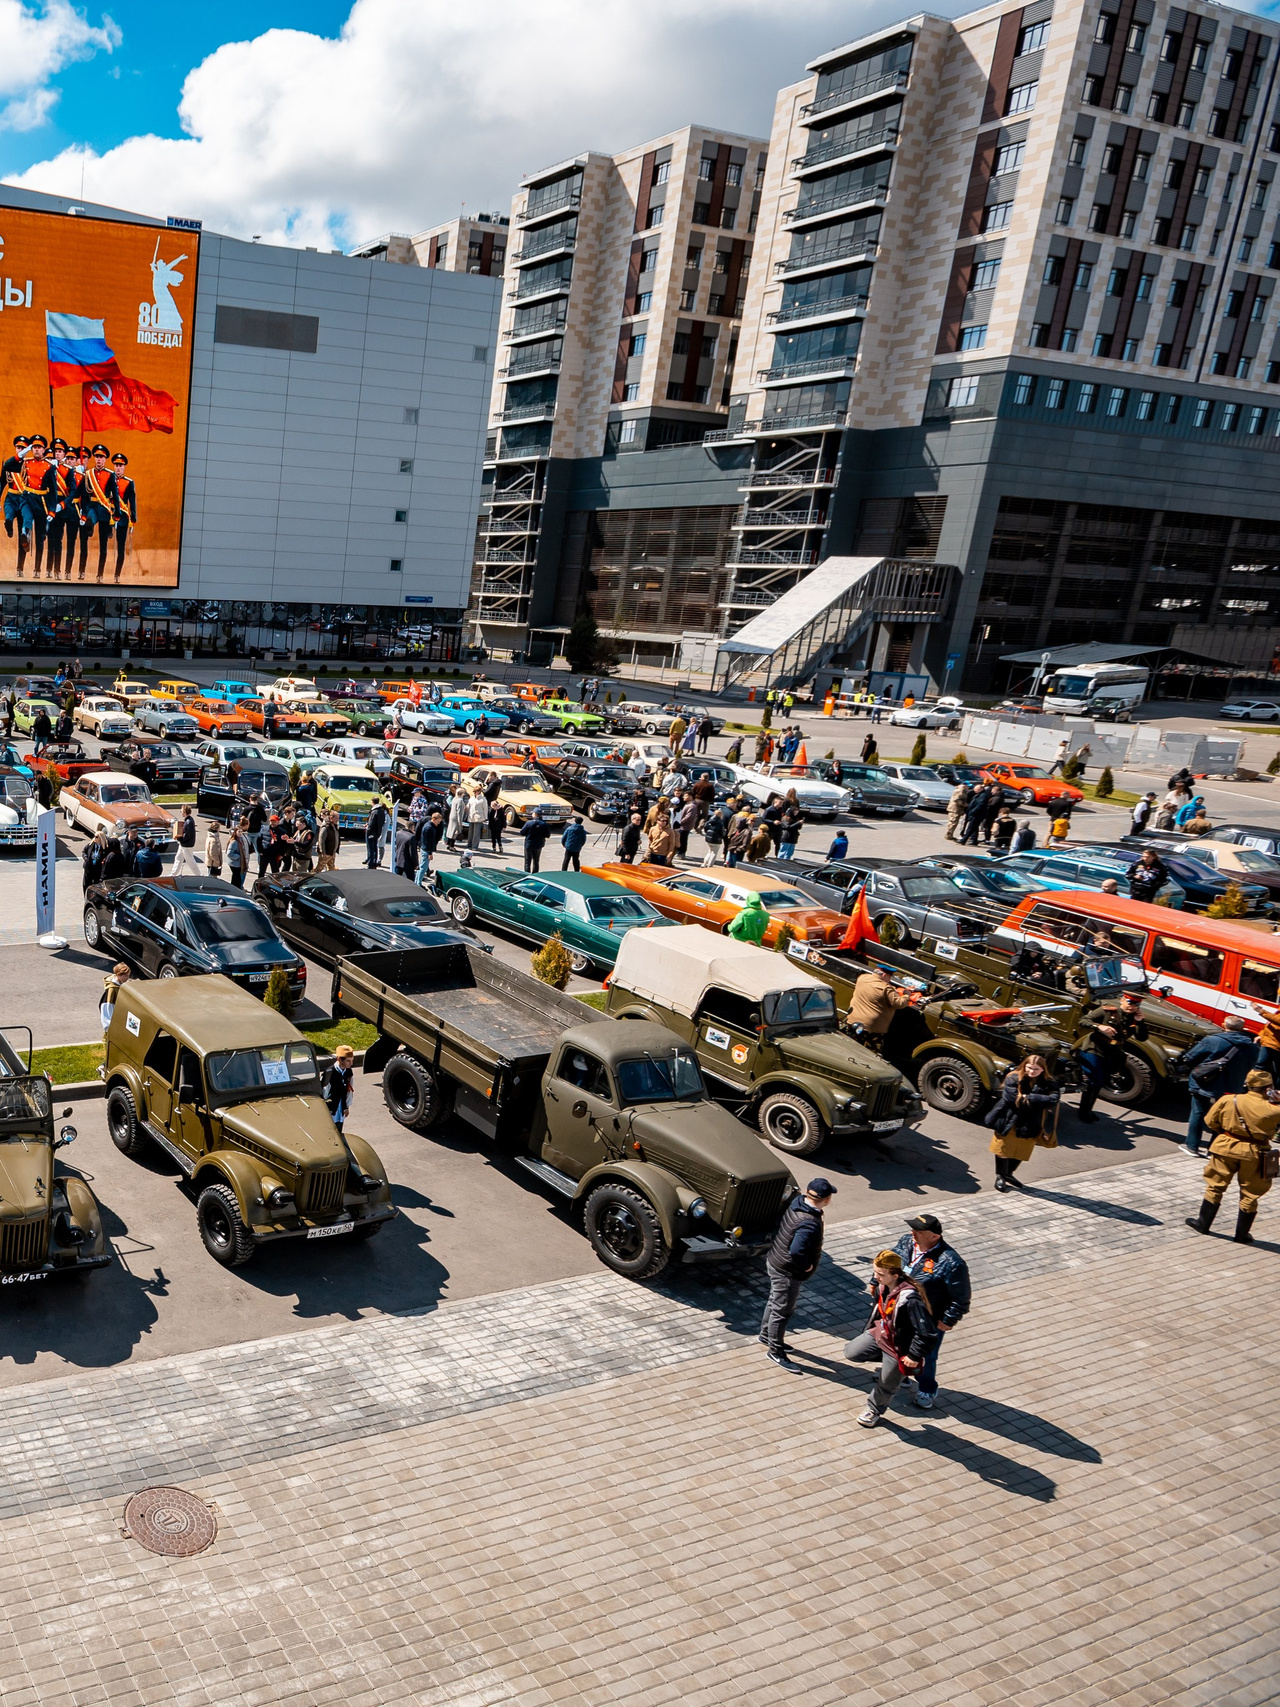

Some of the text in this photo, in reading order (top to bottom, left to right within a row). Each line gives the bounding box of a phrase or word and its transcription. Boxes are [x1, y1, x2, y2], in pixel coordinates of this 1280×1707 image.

[174, 217, 202, 230] MAER
[138, 302, 160, 327] 80
[137, 331, 183, 348] ПОБЕДА!
[41, 842, 49, 906] НАМИ
[1, 1273, 30, 1284] 66-47
